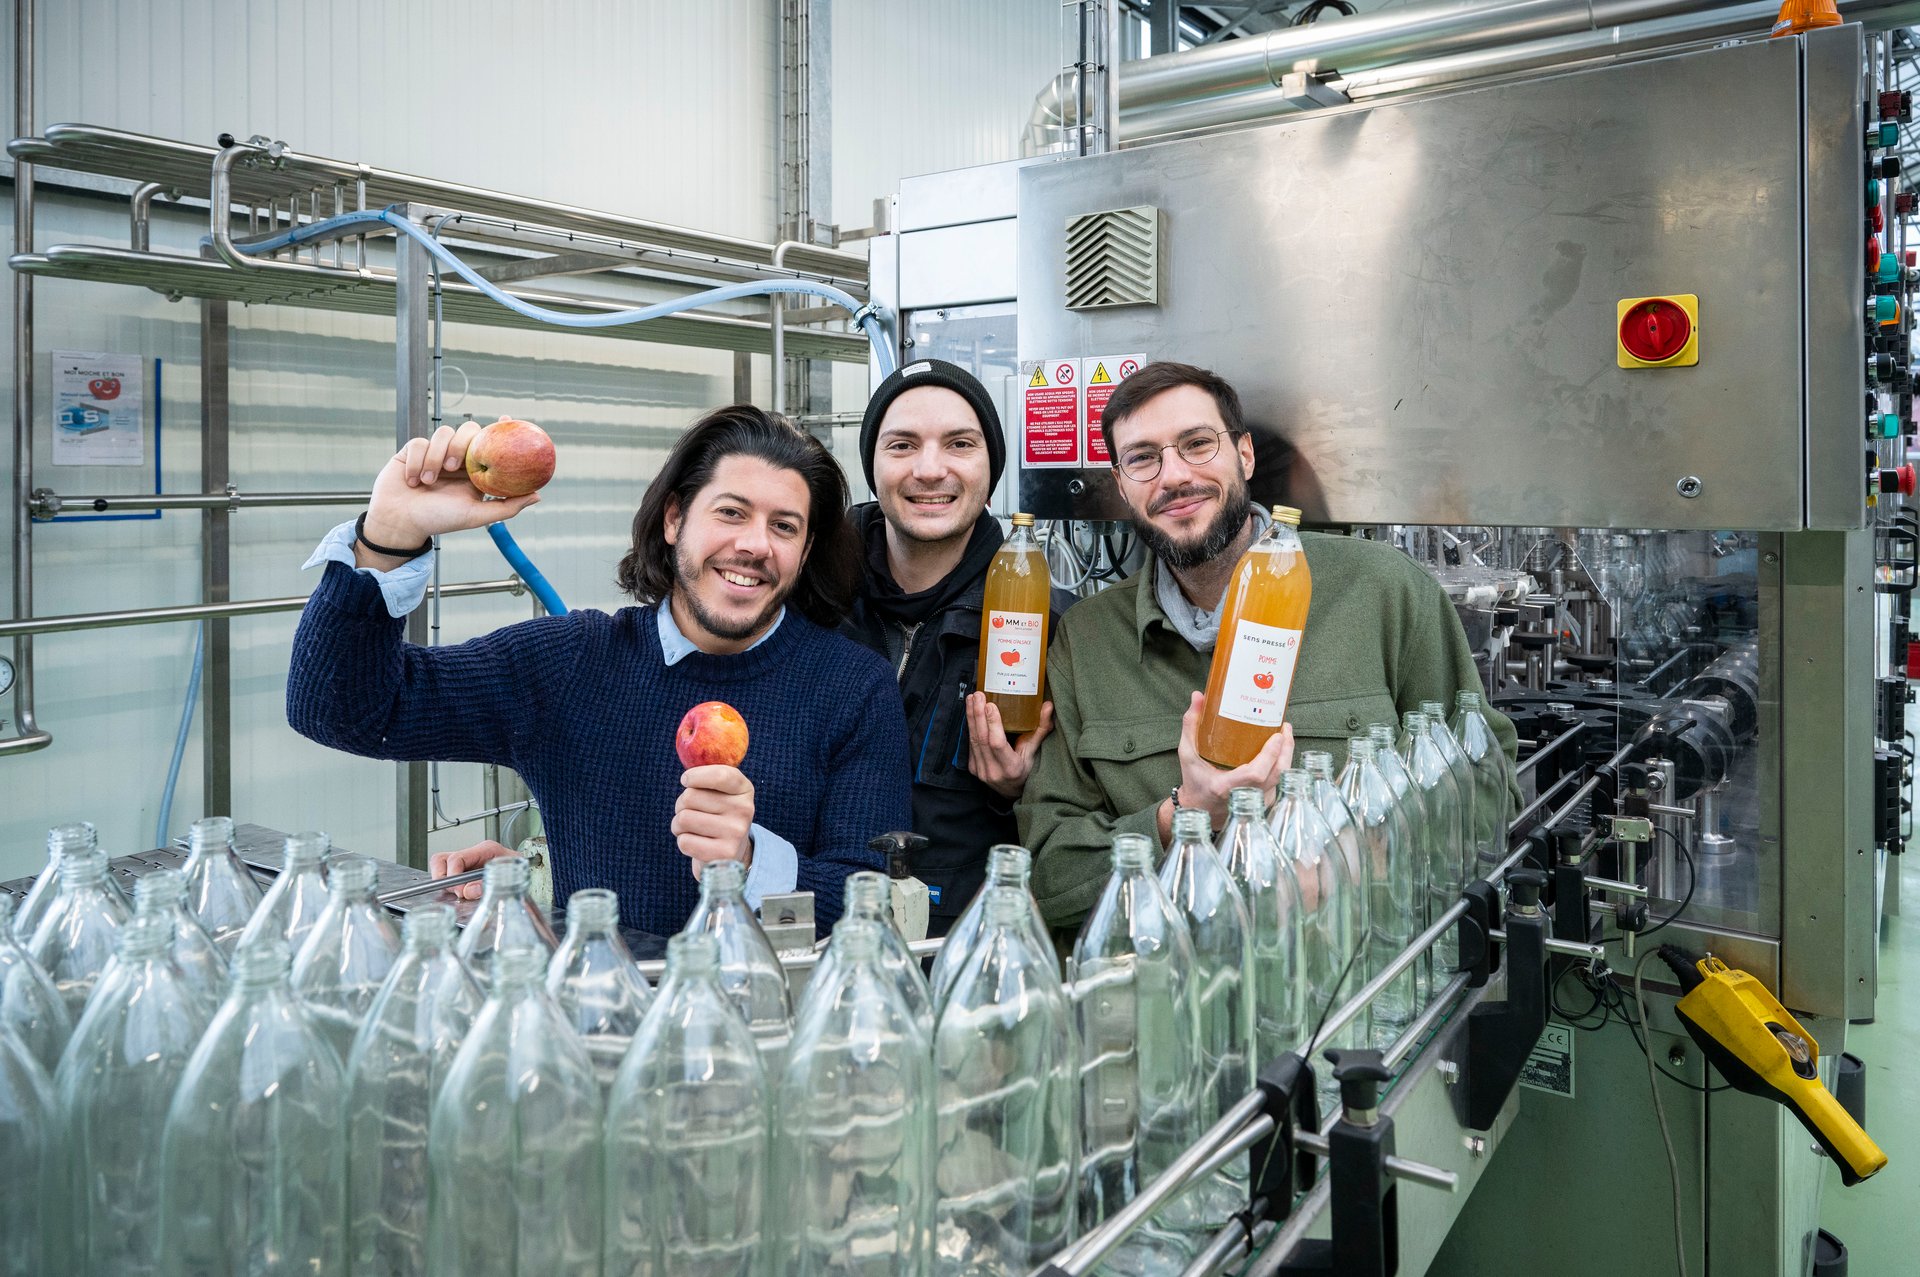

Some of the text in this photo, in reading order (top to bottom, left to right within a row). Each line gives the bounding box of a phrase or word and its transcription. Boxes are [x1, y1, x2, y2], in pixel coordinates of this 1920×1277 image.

[1028, 620, 1039, 628] BIO
[1244, 634, 1260, 643] SENS
[1258, 655, 1278, 665] POMME
[1548, 1033, 1563, 1045] CE
